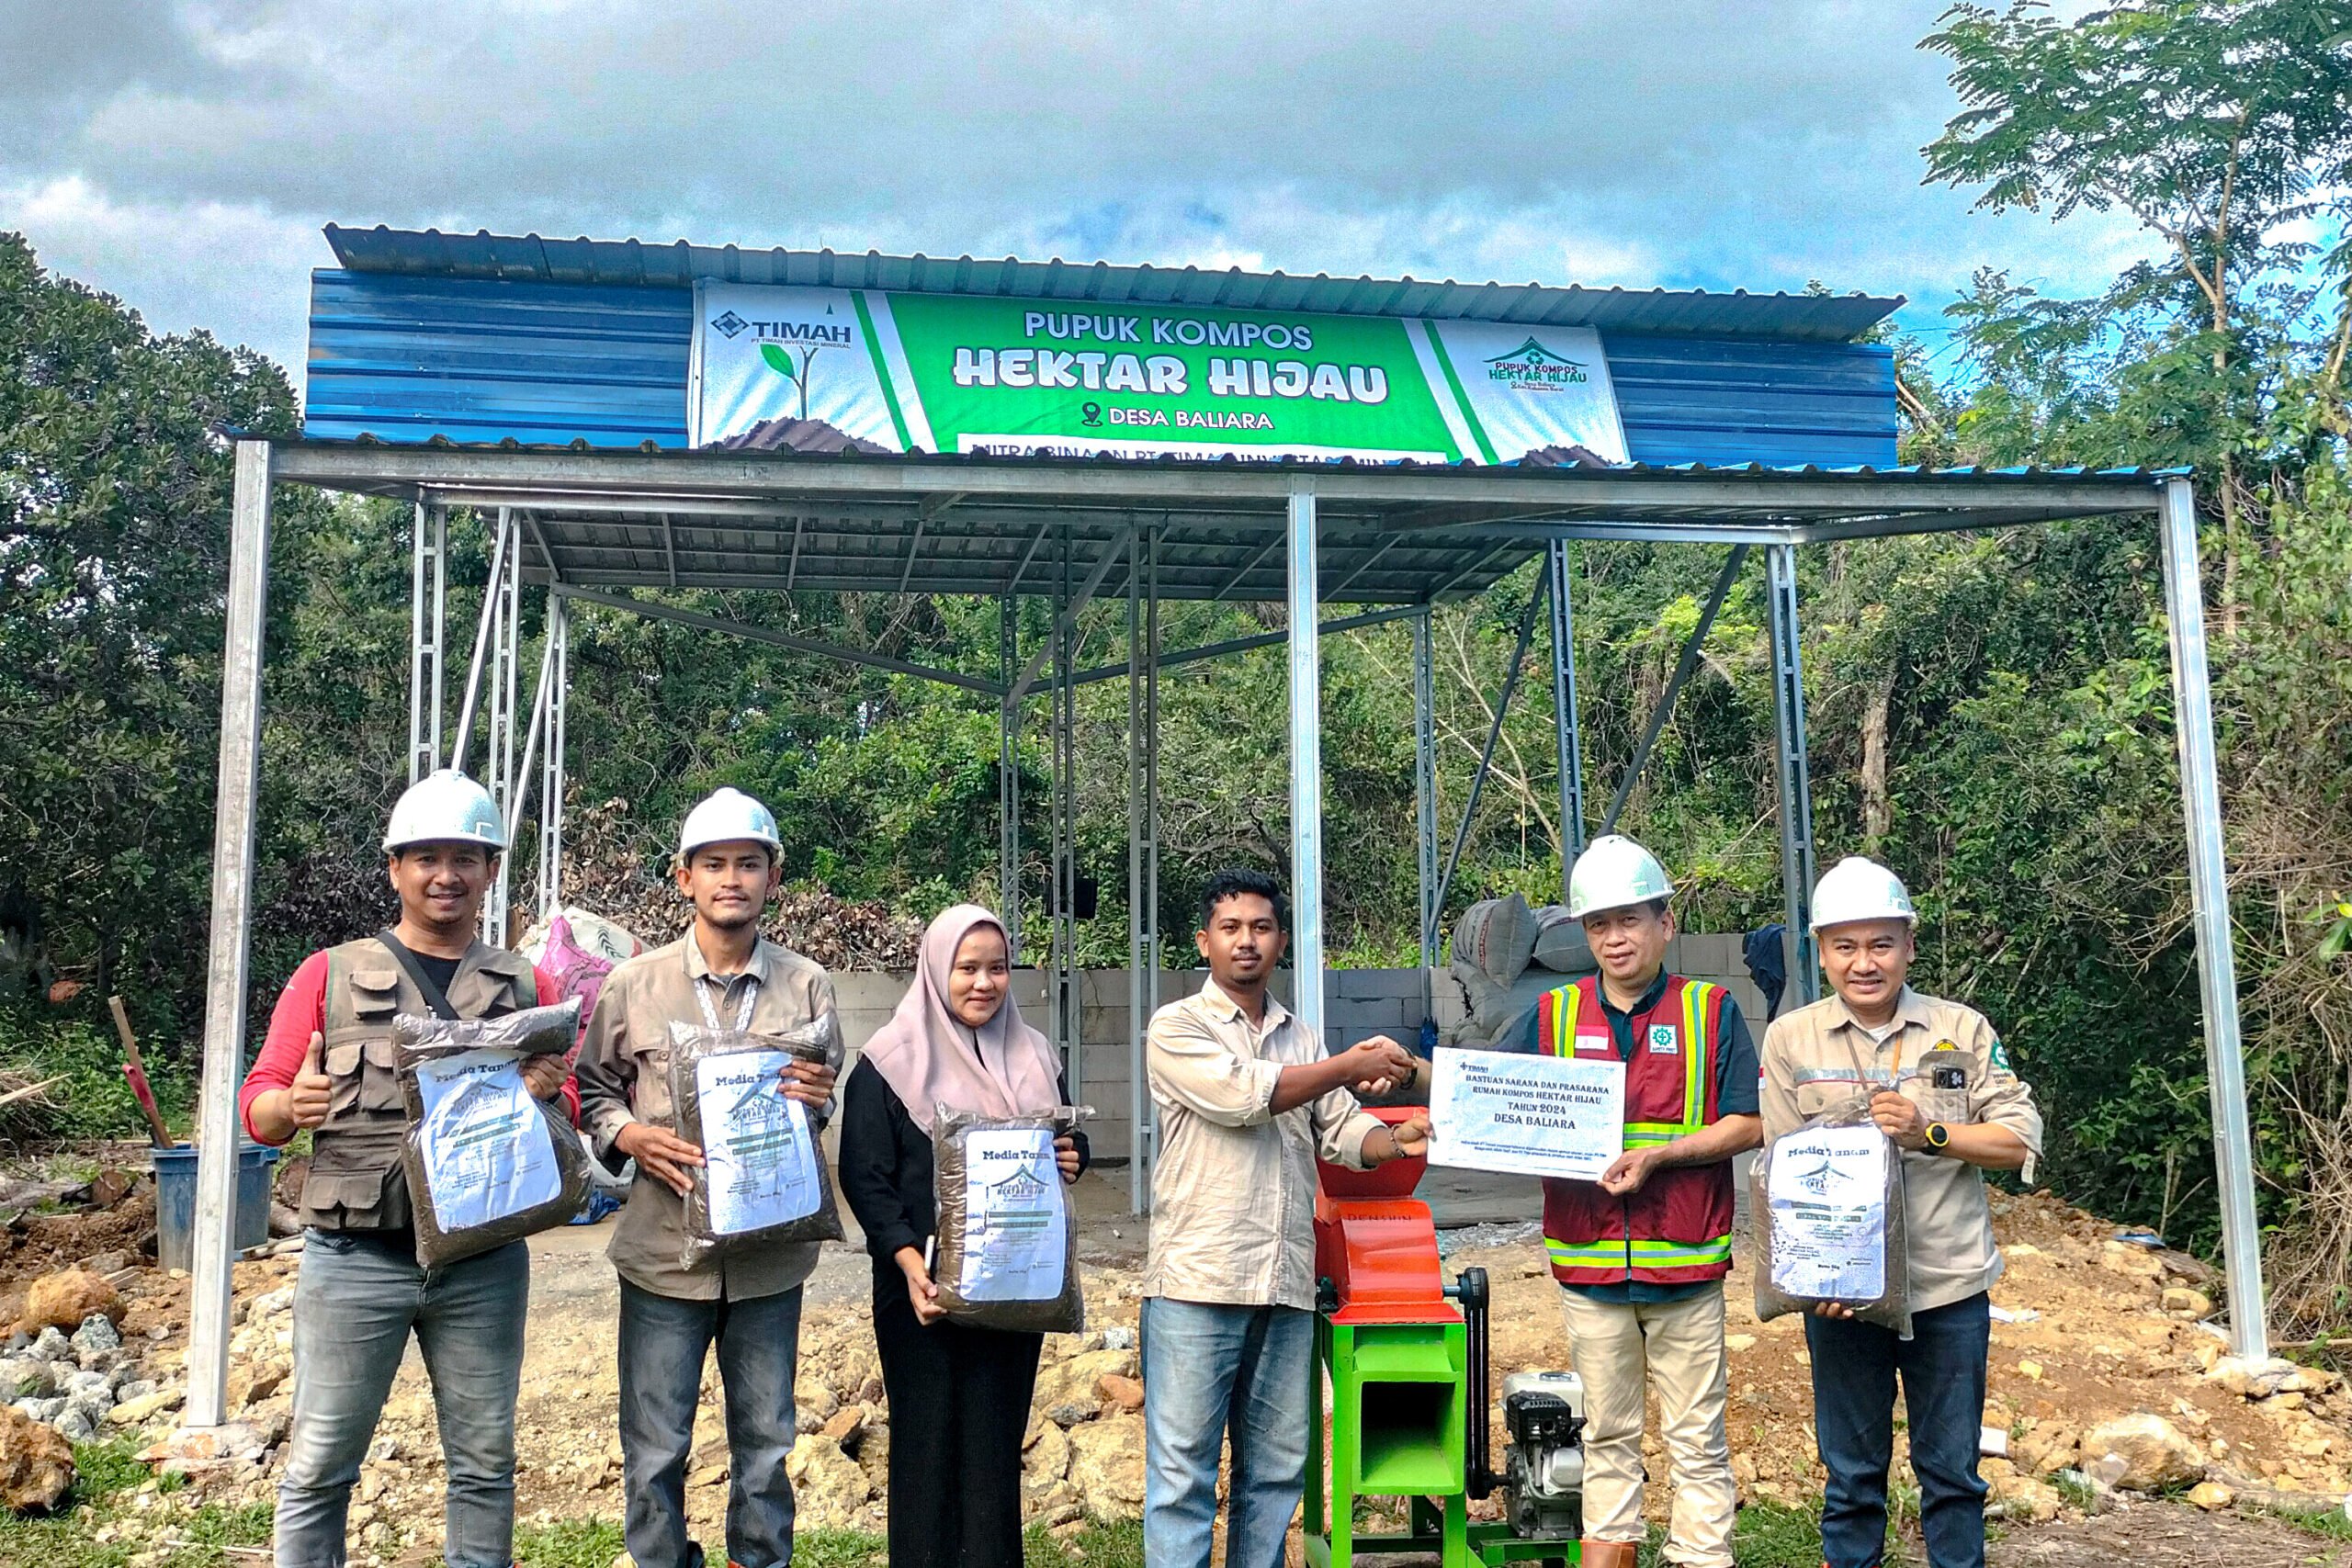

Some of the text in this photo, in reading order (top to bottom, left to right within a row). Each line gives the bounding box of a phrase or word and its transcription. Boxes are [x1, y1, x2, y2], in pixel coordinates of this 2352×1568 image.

[752, 321, 851, 343] TIMAH
[1025, 311, 1314, 351] PUPUK KOMPOS
[953, 348, 1389, 404] HEKTAR HIJAU
[1488, 369, 1588, 383] HEKTAR HIJAU
[1495, 362, 1578, 375] PUPUK KOMPOS
[1109, 408, 1275, 430] DESA BALIARA
[1043, 446, 1127, 459] BINAN
[716, 1074, 755, 1086] Media
[1465, 1074, 1610, 1095] BANTUAN SARANA DAN PRASARANA
[1473, 1086, 1601, 1105] RUMAH KOMPOS HEKTAR HIJAU
[1508, 1101, 1566, 1115] TAHUN 2024
[1494, 1112, 1576, 1130] DESA BALIARA
[982, 1150, 1019, 1160] Media
[1787, 1145, 1825, 1158] Media
